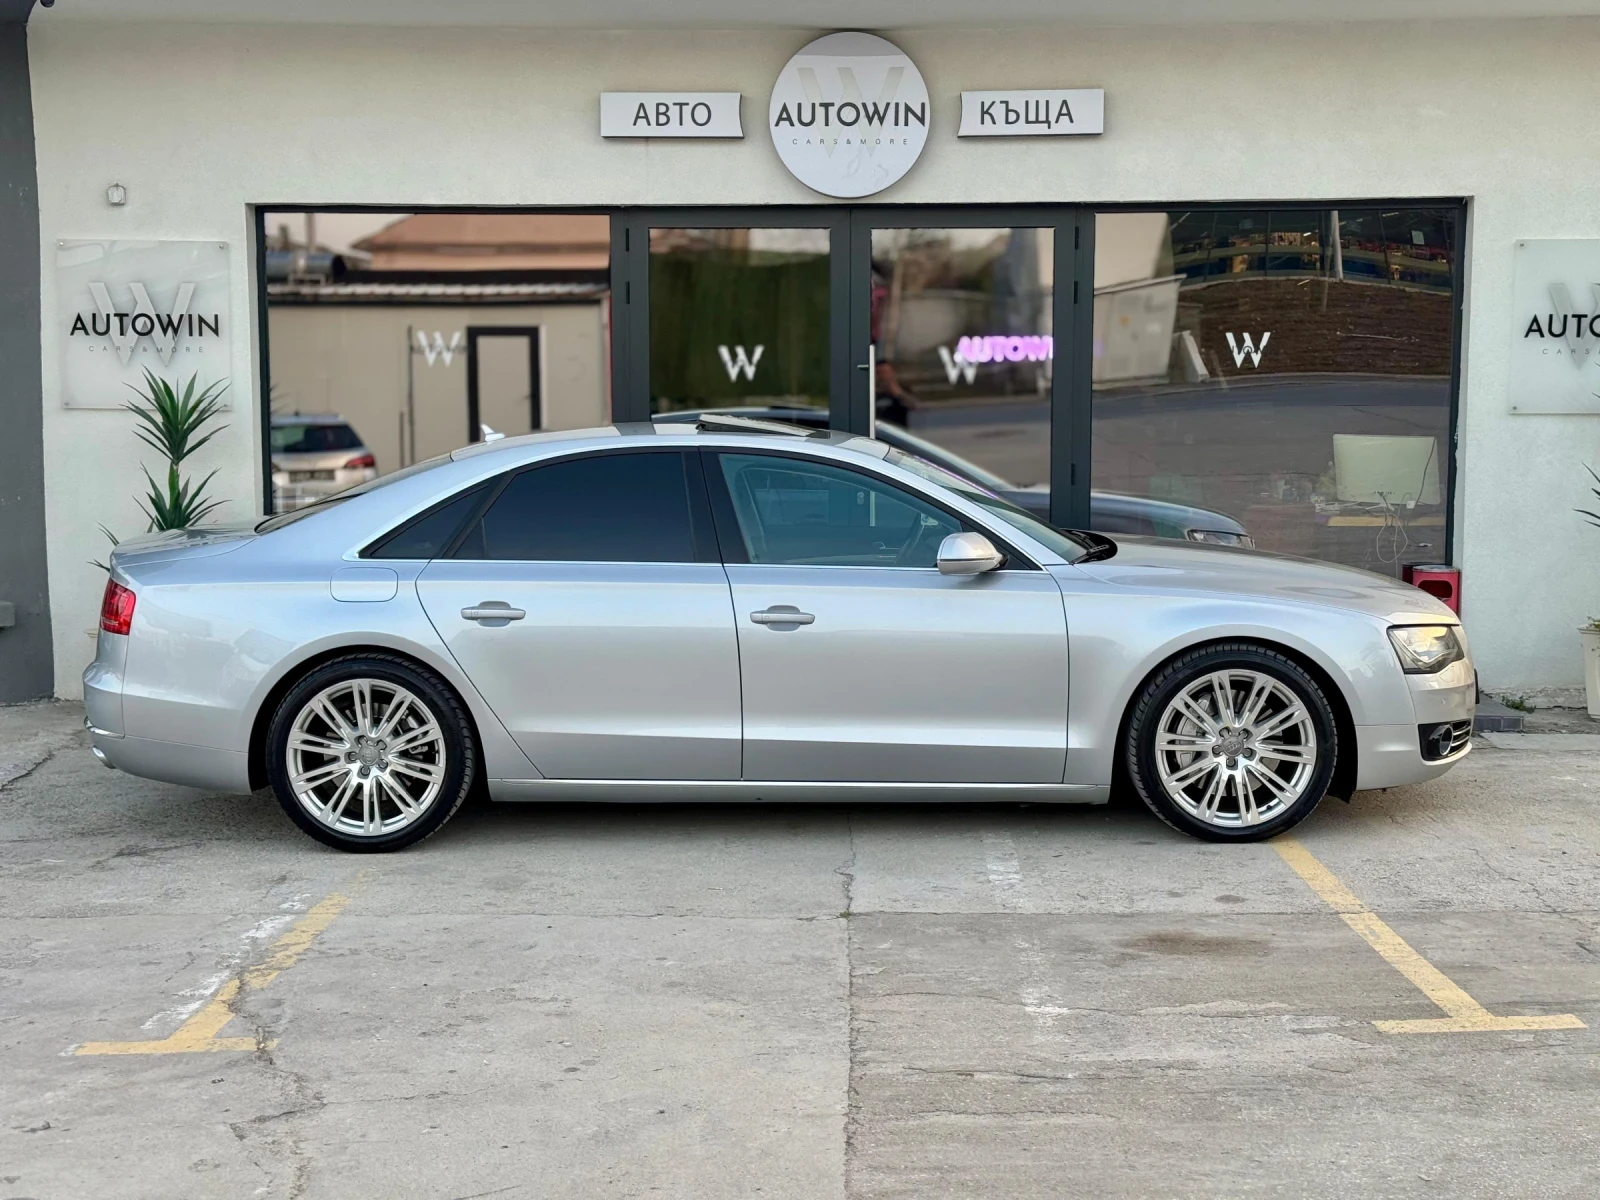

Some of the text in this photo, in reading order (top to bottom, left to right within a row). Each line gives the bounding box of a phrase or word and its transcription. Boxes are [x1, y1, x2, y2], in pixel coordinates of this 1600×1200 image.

[632, 102, 712, 127] АВТО
[774, 102, 926, 127] AUTOWIN
[980, 99, 1074, 129] КЪЩА
[70, 312, 219, 337] AUTOWIN
[417, 330, 461, 368] W
[717, 344, 765, 383] W
[1225, 331, 1271, 369] W
